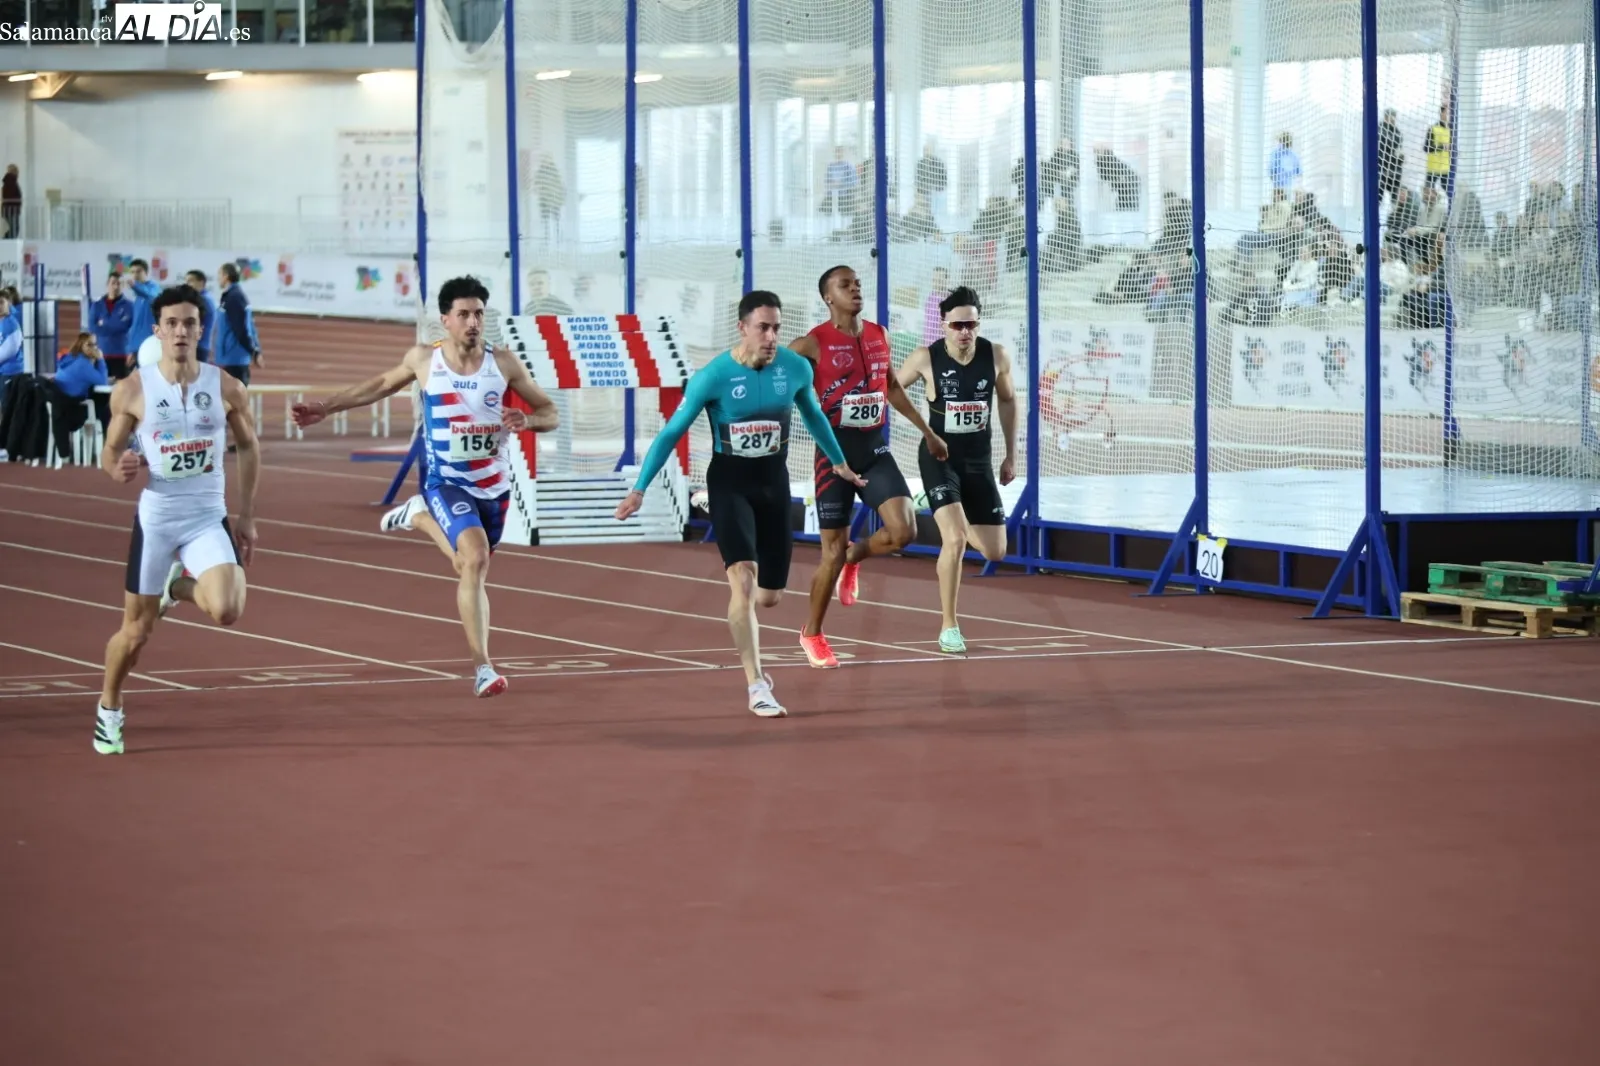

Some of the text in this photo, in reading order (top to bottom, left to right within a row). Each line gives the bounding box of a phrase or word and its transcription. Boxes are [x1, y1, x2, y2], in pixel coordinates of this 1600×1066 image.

[577, 342, 617, 350] MONDO
[580, 352, 619, 360] MONDO
[588, 370, 627, 378] MONDO
[453, 380, 478, 390] aula
[590, 379, 629, 387] MONDO
[849, 404, 880, 420] 280
[953, 411, 983, 426] 155
[460, 434, 494, 452] 156
[740, 432, 773, 450] 287
[170, 449, 207, 472] 257
[1200, 549, 1219, 579] 20
